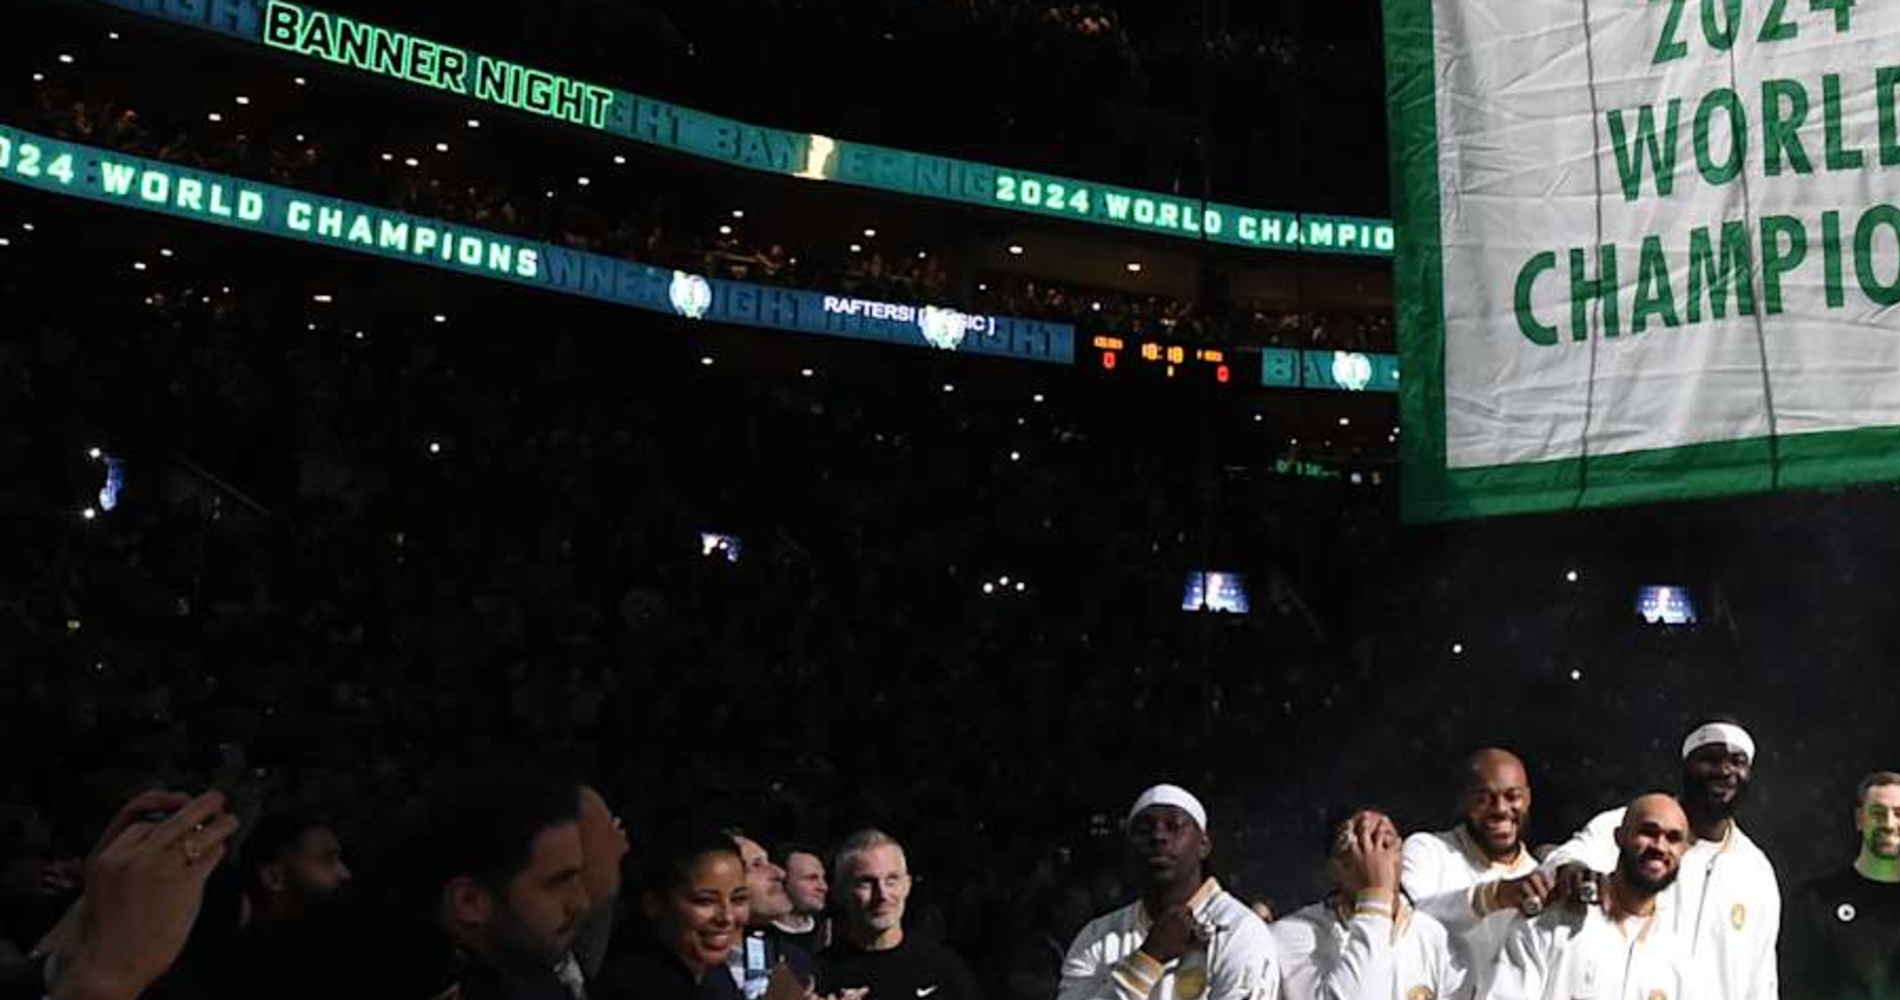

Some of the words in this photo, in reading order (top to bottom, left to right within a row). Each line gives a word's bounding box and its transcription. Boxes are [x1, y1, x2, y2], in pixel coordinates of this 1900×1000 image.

[263, 1, 467, 94] BANNER
[474, 55, 613, 129] NIGHT
[101, 161, 264, 222] WORLD
[287, 200, 539, 277] CHAMPIONS
[995, 176, 1089, 214] 2024
[1105, 193, 1222, 235] WORLD
[1238, 214, 1395, 250] CHAMPIO
[1103, 352, 1115, 369] 0
[1217, 365, 1229, 382] 0
